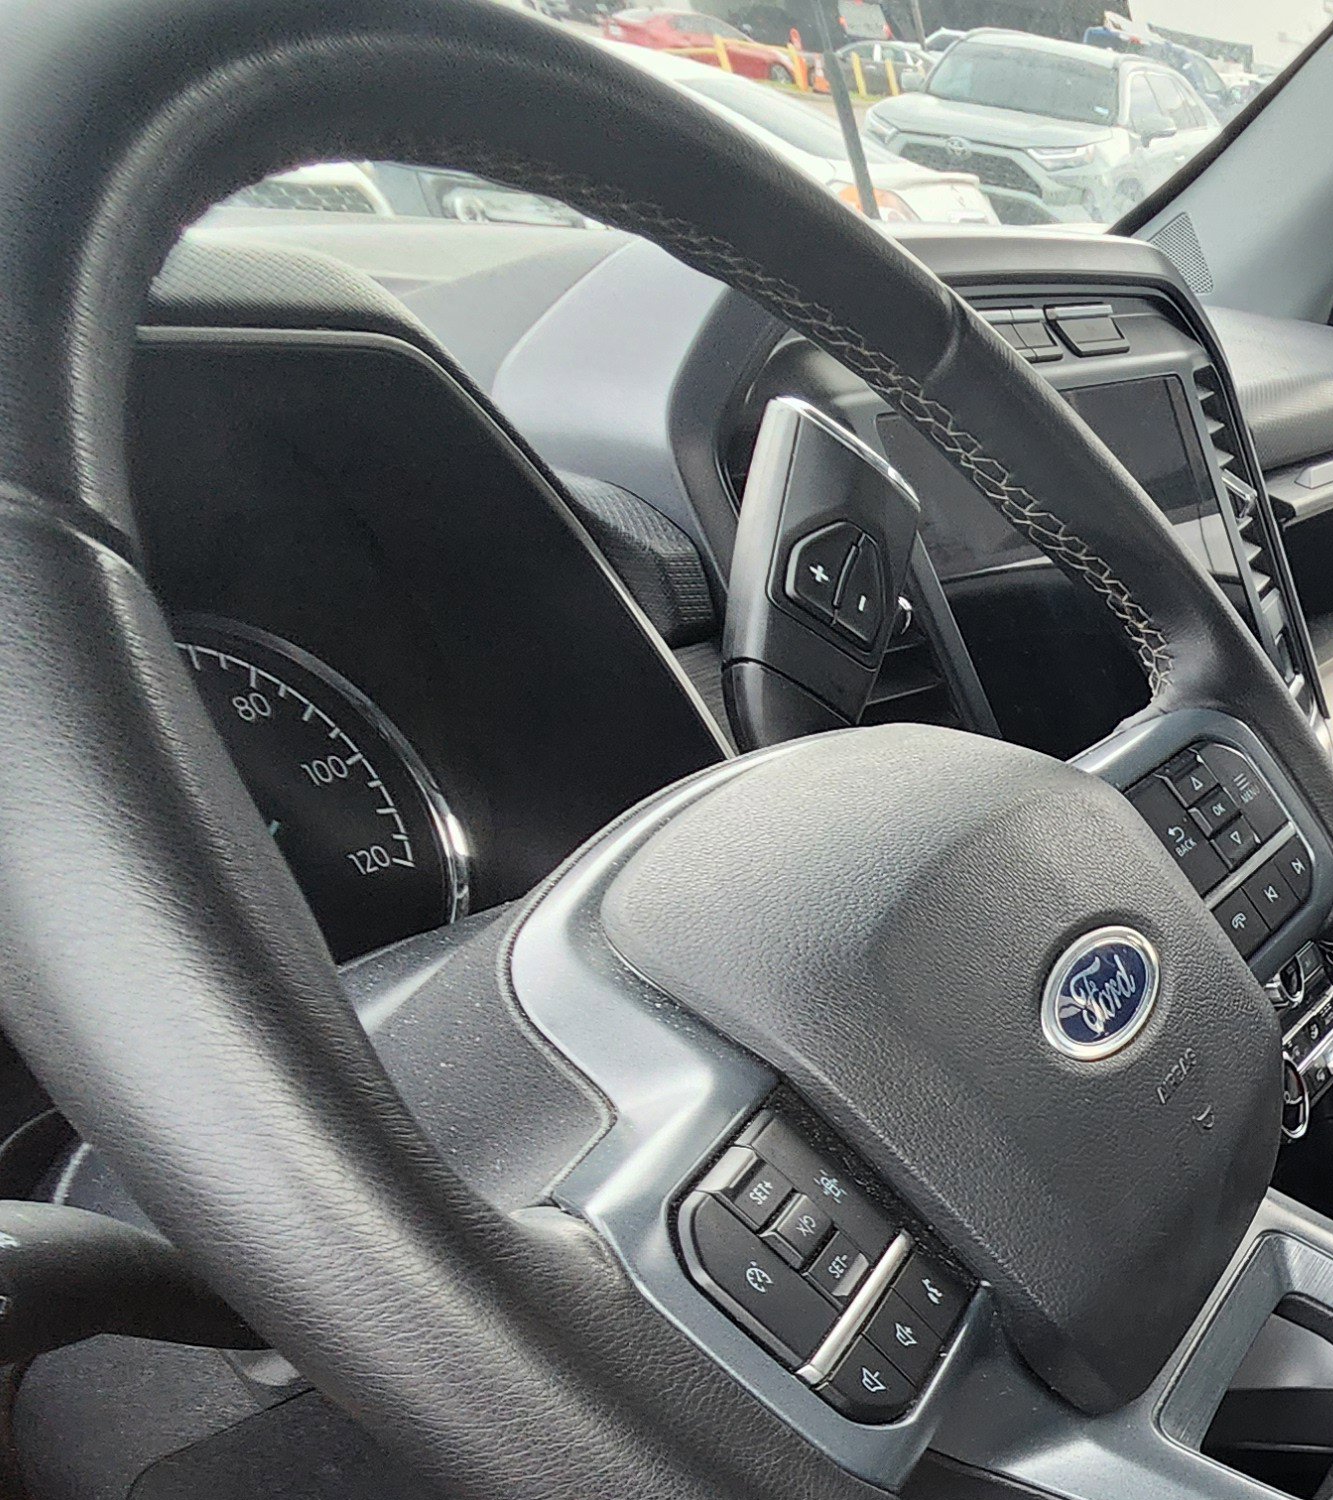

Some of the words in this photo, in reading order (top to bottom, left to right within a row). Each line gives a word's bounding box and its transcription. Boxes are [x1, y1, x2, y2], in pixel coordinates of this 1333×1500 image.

[232, 692, 271, 721] 80
[301, 755, 348, 786] 100
[1212, 803, 1226, 816] OK
[347, 845, 390, 875] 120
[1175, 838, 1198, 857] BACK
[1069, 953, 1136, 1034] Ford
